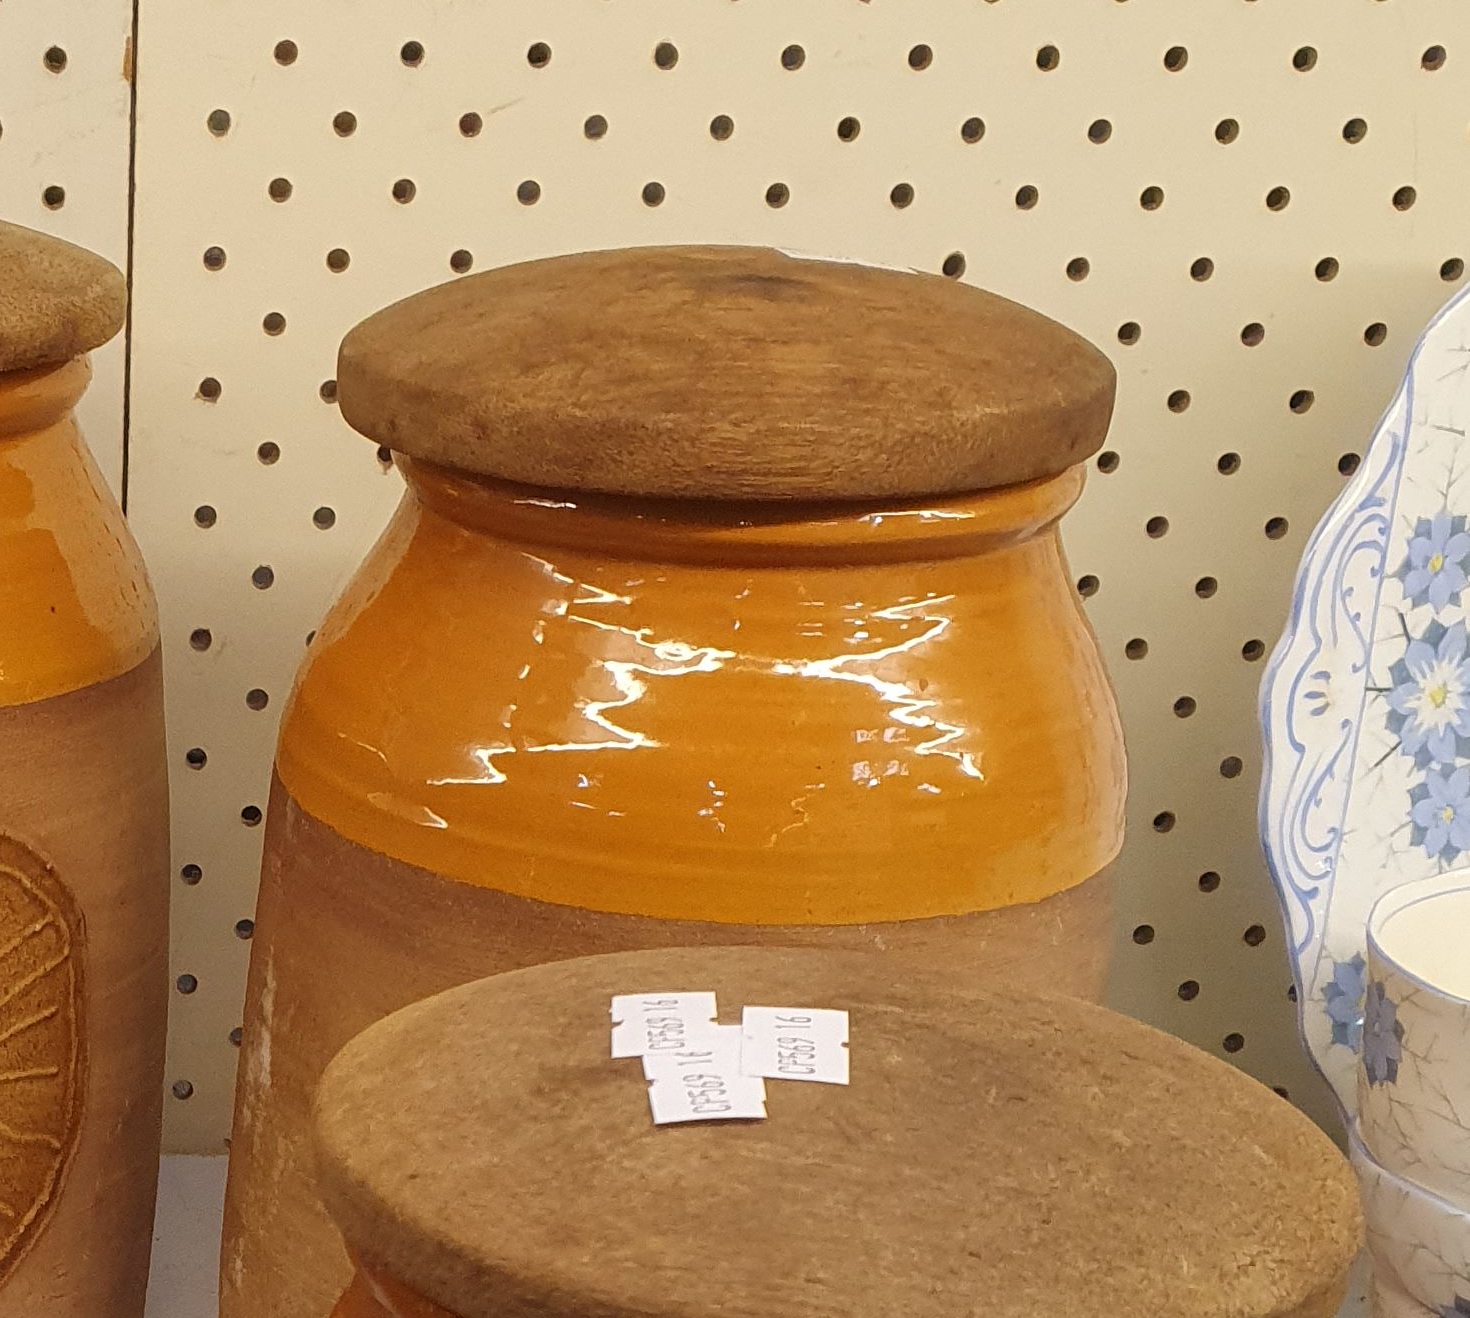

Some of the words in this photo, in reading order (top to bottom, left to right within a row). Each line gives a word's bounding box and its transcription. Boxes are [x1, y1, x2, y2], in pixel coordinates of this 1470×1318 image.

[642, 998, 679, 1012] 16
[774, 1014, 813, 1030] 16
[645, 1016, 686, 1051] CF569
[777, 1036, 817, 1075] CF569
[682, 1073, 732, 1114] CF569
